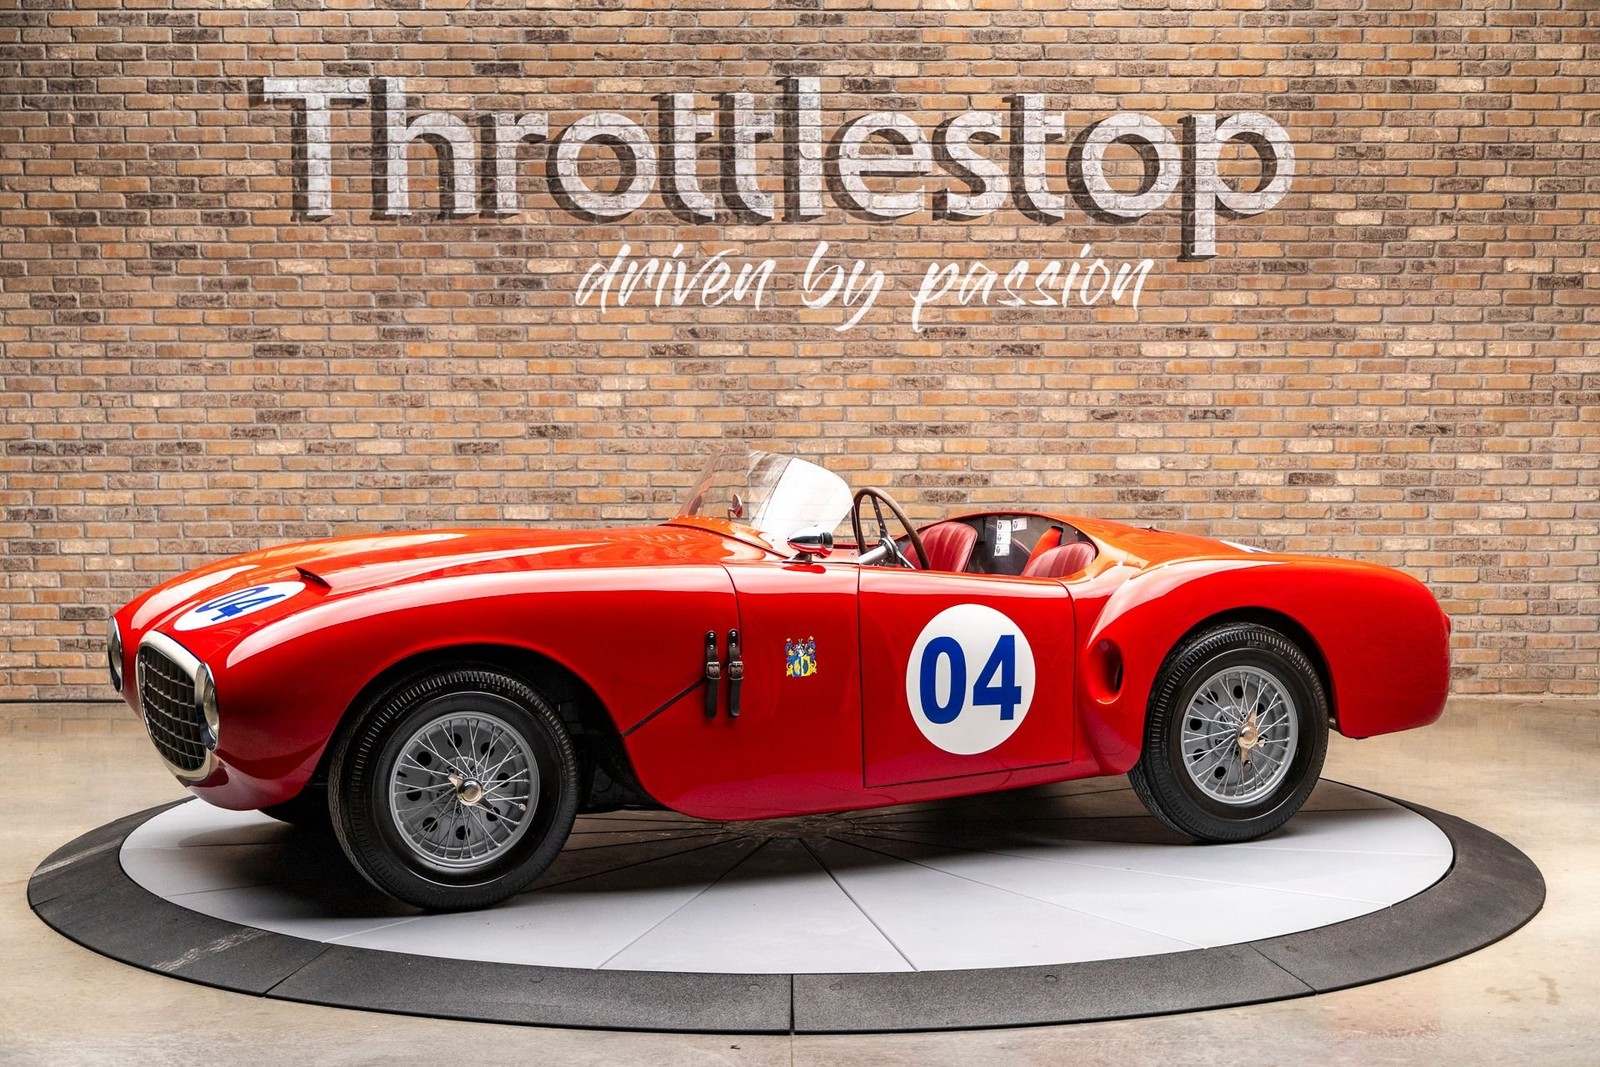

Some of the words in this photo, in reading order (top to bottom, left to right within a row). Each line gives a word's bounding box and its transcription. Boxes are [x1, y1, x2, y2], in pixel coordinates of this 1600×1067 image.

[249, 76, 1297, 262] Throttlestop
[574, 243, 777, 315] driven
[801, 240, 884, 332] by
[909, 243, 1155, 333] passion
[195, 586, 287, 622] 04
[919, 634, 1022, 725] 04
